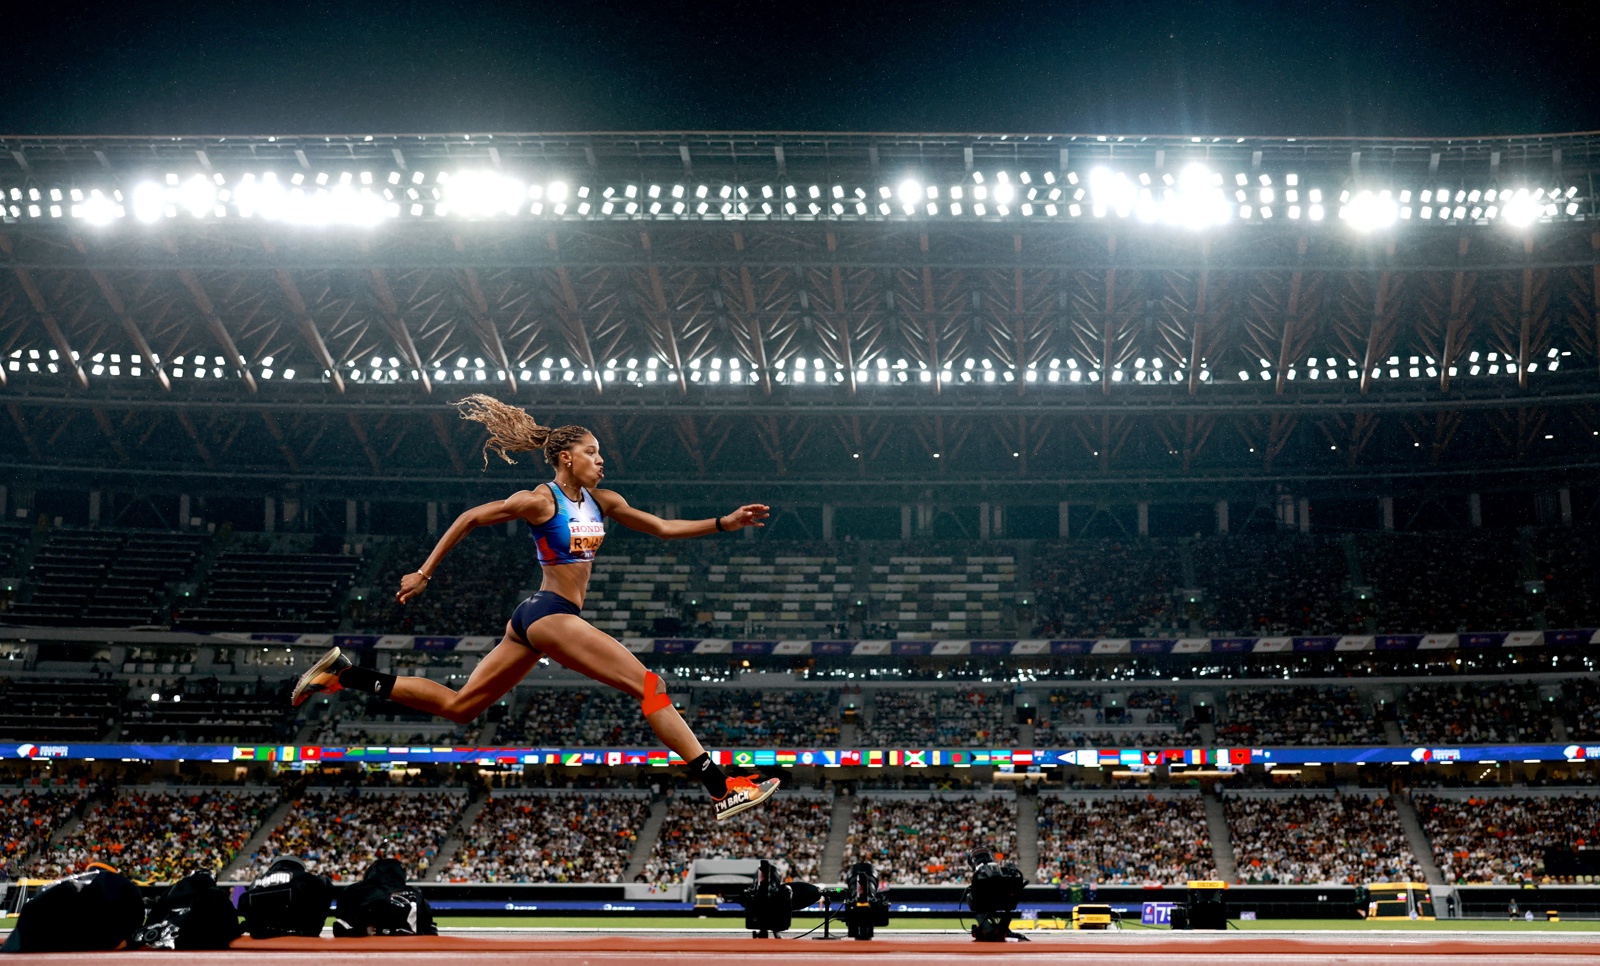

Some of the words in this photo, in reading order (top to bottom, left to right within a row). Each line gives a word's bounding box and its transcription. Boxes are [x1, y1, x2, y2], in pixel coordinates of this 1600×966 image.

[571, 525, 603, 533] HOND
[714, 800, 727, 812] I'M
[727, 790, 750, 808] BACK
